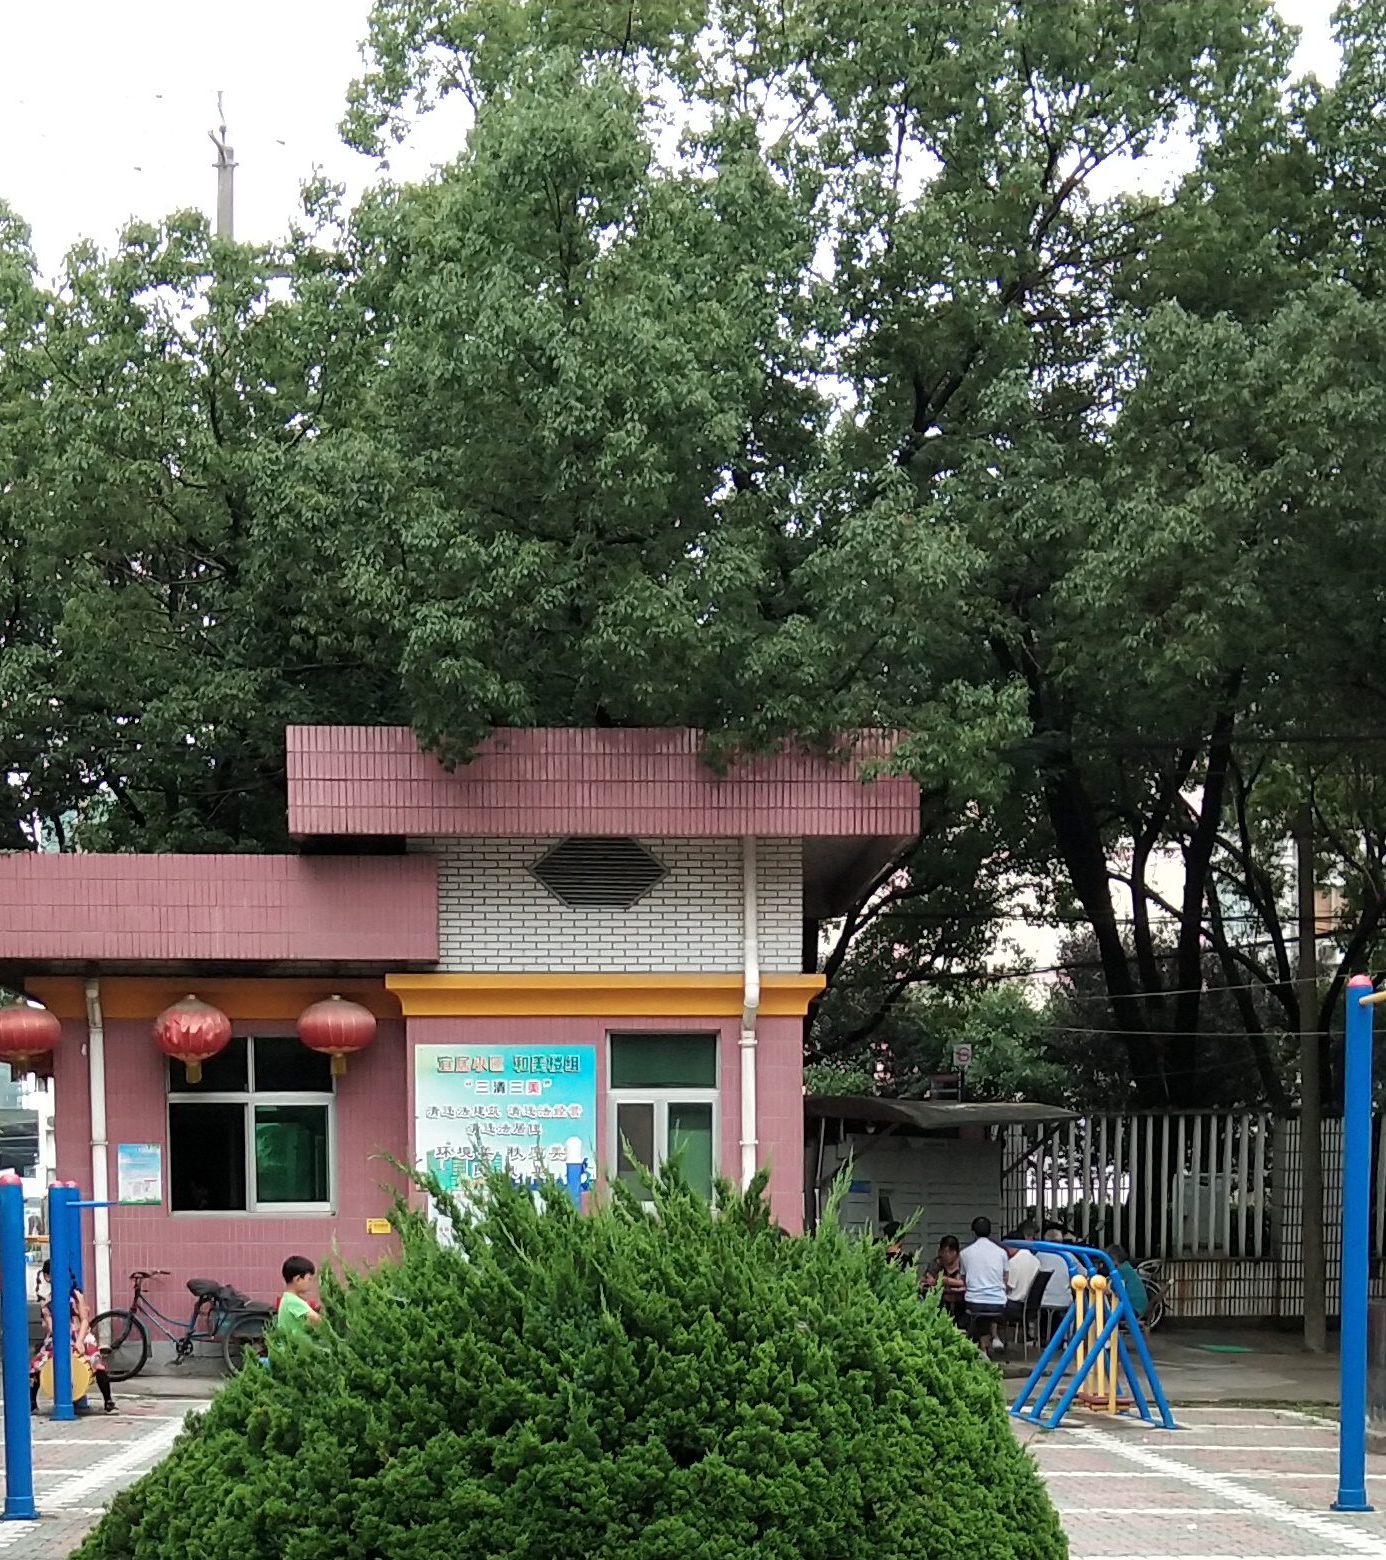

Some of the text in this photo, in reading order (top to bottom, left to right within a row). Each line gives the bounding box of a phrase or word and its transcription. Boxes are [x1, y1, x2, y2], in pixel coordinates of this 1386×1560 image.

[437, 1055, 581, 1074] 宜居小区 和美楼组
[426, 1104, 583, 1119] 清违法建筑 清违法经营
